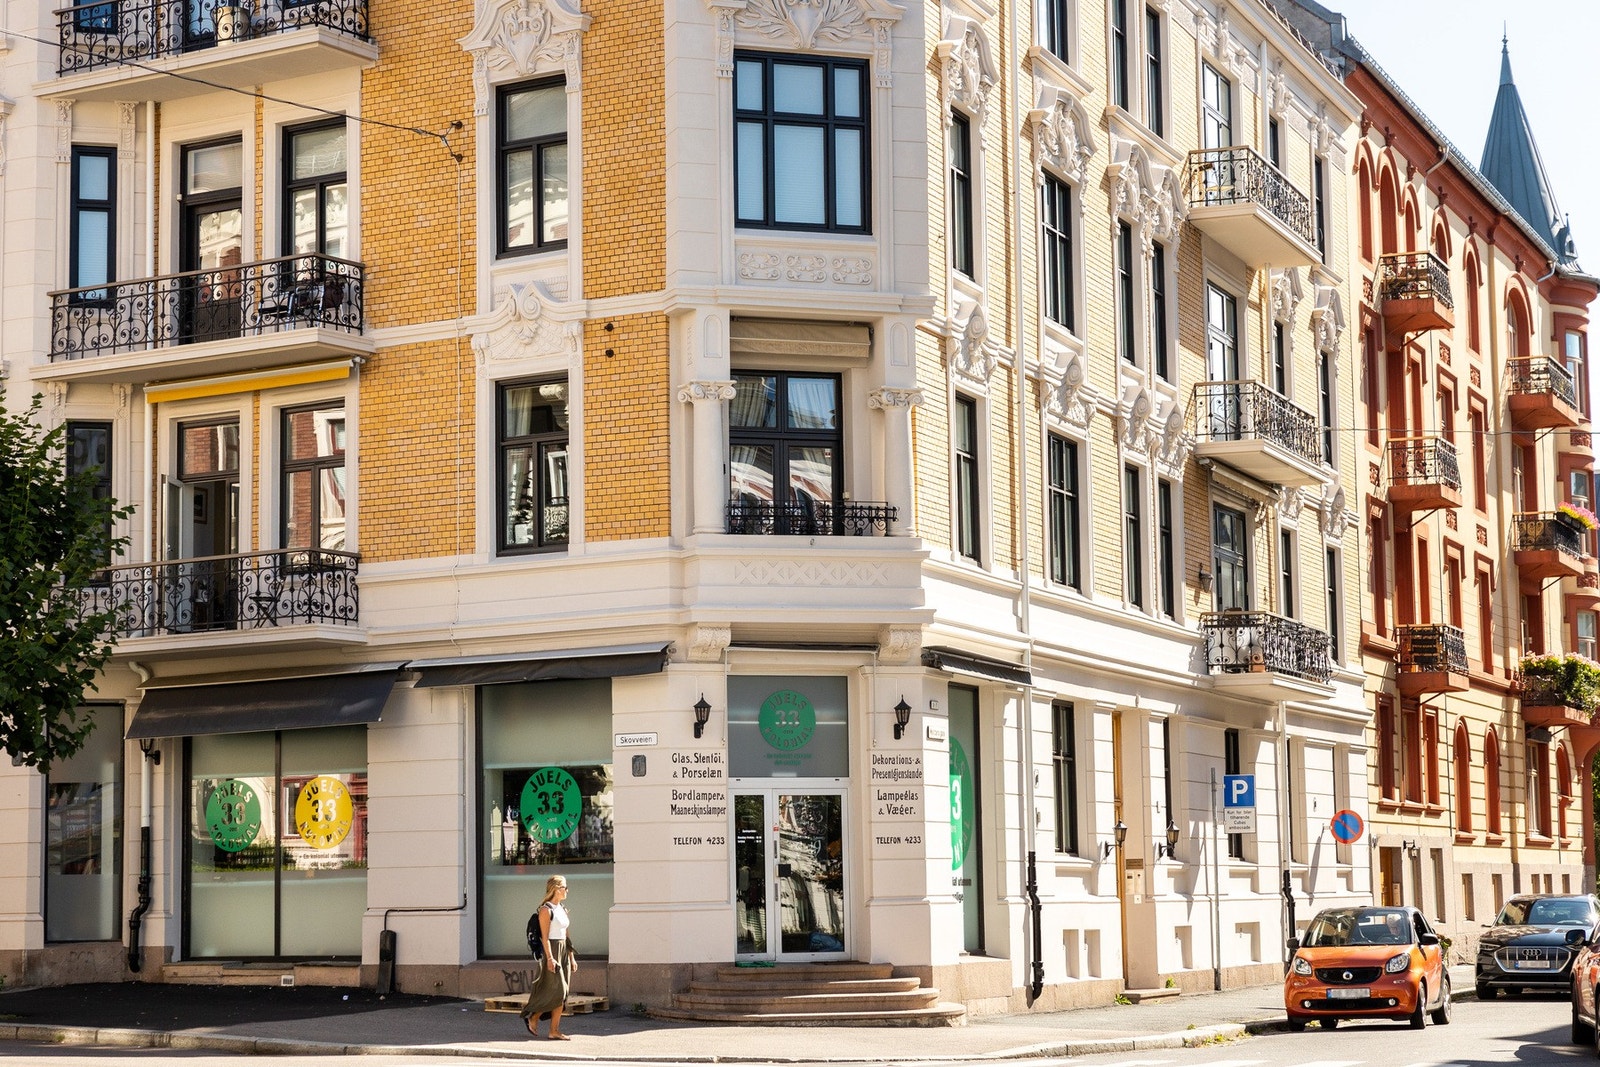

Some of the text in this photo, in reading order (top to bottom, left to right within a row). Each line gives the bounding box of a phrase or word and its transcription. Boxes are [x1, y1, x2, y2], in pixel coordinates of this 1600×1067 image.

[769, 693, 807, 710] JUELS
[775, 710, 800, 729] 33
[620, 736, 652, 744] Skovveien
[764, 726, 812, 748] KOLONIAL
[529, 770, 573, 794] JUELS
[672, 766, 722, 778] & Porselæn
[215, 782, 253, 804] JUELS
[305, 779, 344, 801] JUELS
[877, 789, 919, 803] Lampeglas
[1232, 779, 1249, 804] P
[311, 798, 337, 822] 33
[537, 790, 565, 815] 33
[670, 804, 727, 819] Maaneskinslamper
[221, 802, 246, 826] 33
[210, 822, 258, 849] KOLONIAL
[299, 819, 349, 847] KOLONIAL
[524, 812, 578, 840] KOLONIAL
[673, 836, 725, 845] TELEFON 4233
[875, 835, 922, 845] TELEFON 4233
